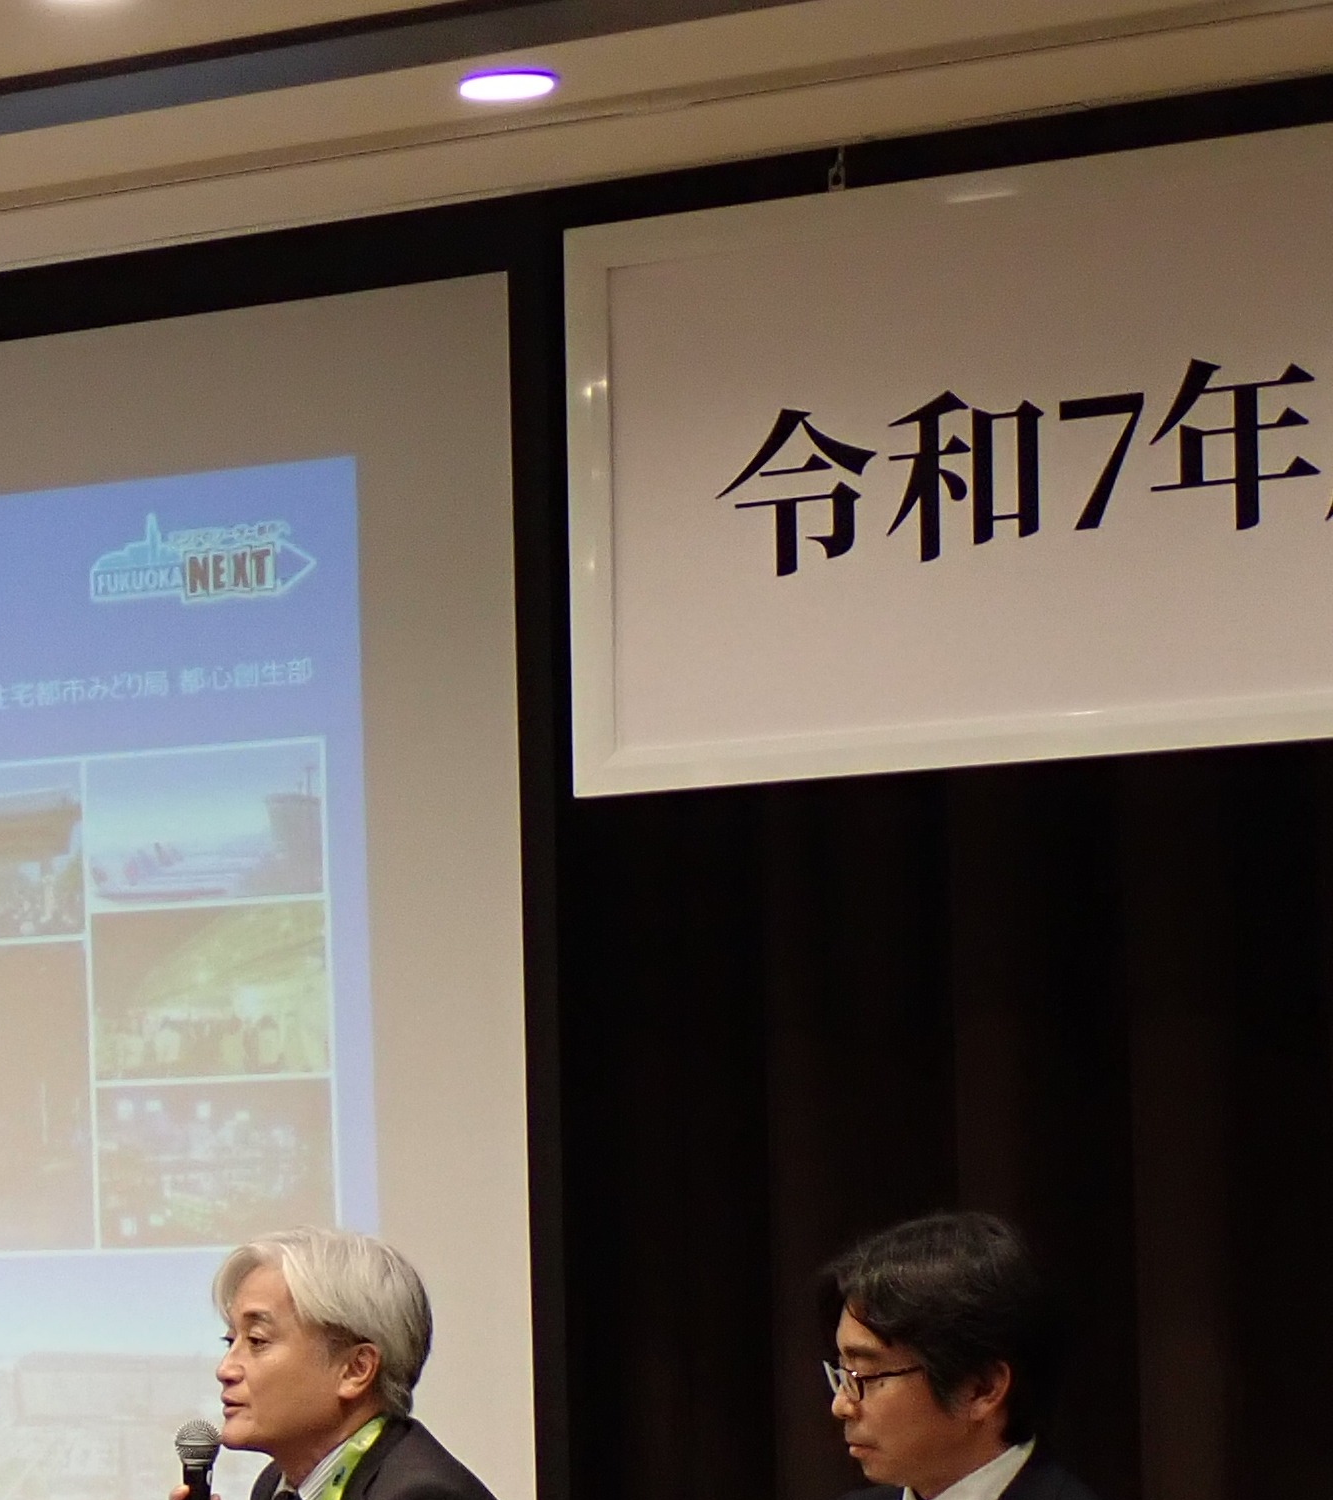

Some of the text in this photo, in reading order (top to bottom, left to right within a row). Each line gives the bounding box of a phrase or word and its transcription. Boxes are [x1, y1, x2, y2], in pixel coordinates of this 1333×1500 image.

[715, 358, 1333, 578] 令和7年
[96, 548, 272, 594] FUKUOKA NEXT
